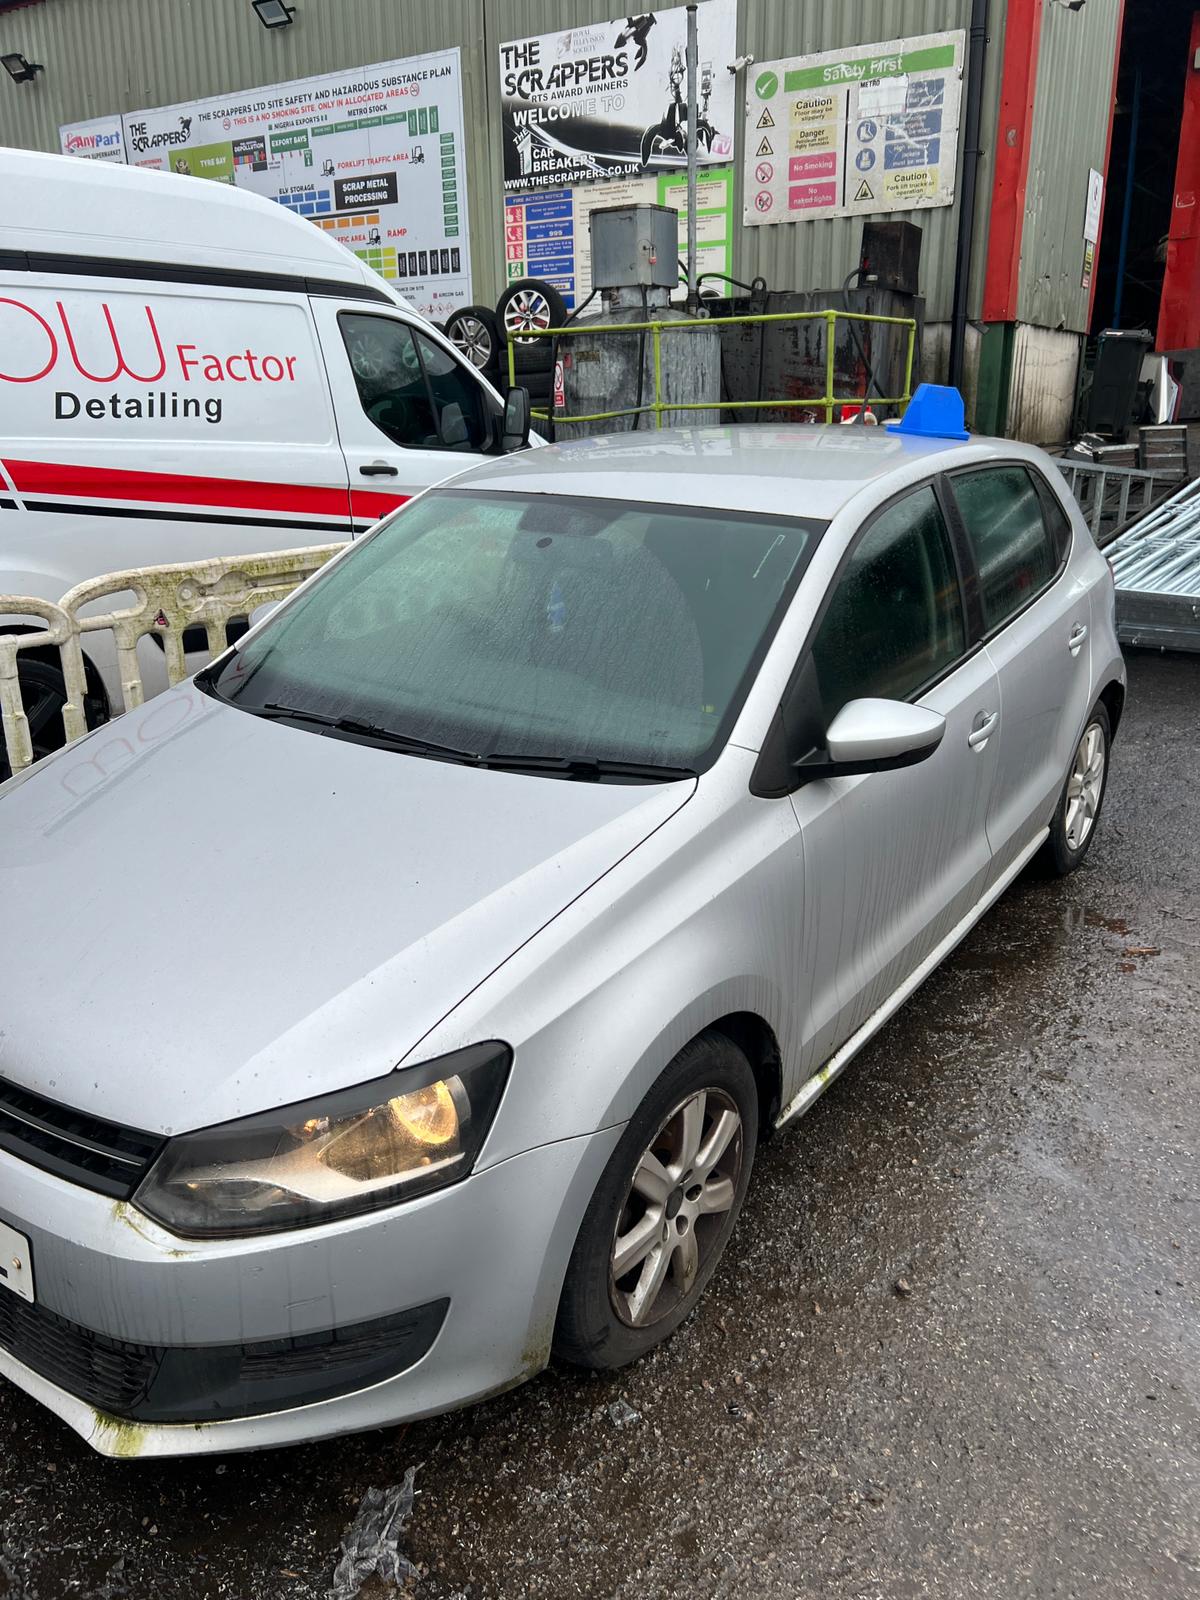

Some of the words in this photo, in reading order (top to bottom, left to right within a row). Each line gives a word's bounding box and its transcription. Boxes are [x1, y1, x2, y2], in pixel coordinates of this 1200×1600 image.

[501, 41, 540, 70] THE
[504, 52, 629, 99] SCRAPPERS
[823, 64, 866, 82] Safety
[870, 55, 902, 74] First
[531, 93, 548, 103] RTS
[550, 87, 583, 101] AWARD
[585, 79, 628, 94] WINNERS
[860, 80, 880, 88] METRO
[198, 112, 211, 122] THE
[212, 105, 251, 120] SCRAPPERS
[253, 102, 266, 112] LTD
[268, 99, 283, 109] SITE
[285, 93, 312, 106] SAFETY
[314, 87, 330, 100] AND
[332, 81, 379, 97] HAZARDOUS
[381, 70, 428, 88] SUBSTANCE
[429, 66, 452, 79] PLAN
[233, 117, 247, 126] THIS
[248, 116, 254, 124] IS
[261, 112, 270, 121] NO
[271, 107, 300, 119] SMOKING
[318, 101, 335, 111] ONLY
[336, 98, 343, 107] IN
[345, 91, 384, 106] ALLOCATED
[386, 87, 409, 98] AREAS
[347, 107, 368, 117] METRO
[369, 103, 388, 113] STOCK
[513, 98, 597, 127] WELCOME
[601, 94, 626, 112] TO
[796, 98, 832, 110] Caution
[130, 122, 147, 138] THE
[274, 121, 295, 130] NIGERIA
[296, 116, 320, 126] EXPORTS
[132, 130, 187, 152] SCRAPPERS
[271, 137, 293, 147] EXPORT
[293, 135, 307, 143] BAYS
[512, 127, 530, 145] THE
[800, 130, 825, 139] Danger
[337, 159, 365, 169] FORKLIFT
[367, 155, 391, 165] TRAFFIC
[392, 153, 409, 161] AREA
[516, 133, 532, 175] 1
[533, 148, 554, 159] CAR
[200, 158, 215, 168] TYRE
[216, 156, 226, 165] BAY
[533, 153, 597, 172] BREAKERS
[804, 161, 833, 170] Smoking
[504, 163, 639, 190] WWW.THESCRAPPERS.CO.UK
[894, 172, 928, 183] Caution
[279, 187, 289, 195] ELV
[289, 184, 315, 194] STORAGE
[342, 181, 365, 192] SCRAP
[366, 178, 388, 189] METAL
[344, 191, 388, 204] PROCESSING
[387, 228, 407, 238] RAMP
[176, 344, 297, 382] Factor
[55, 391, 223, 424] Detailing
